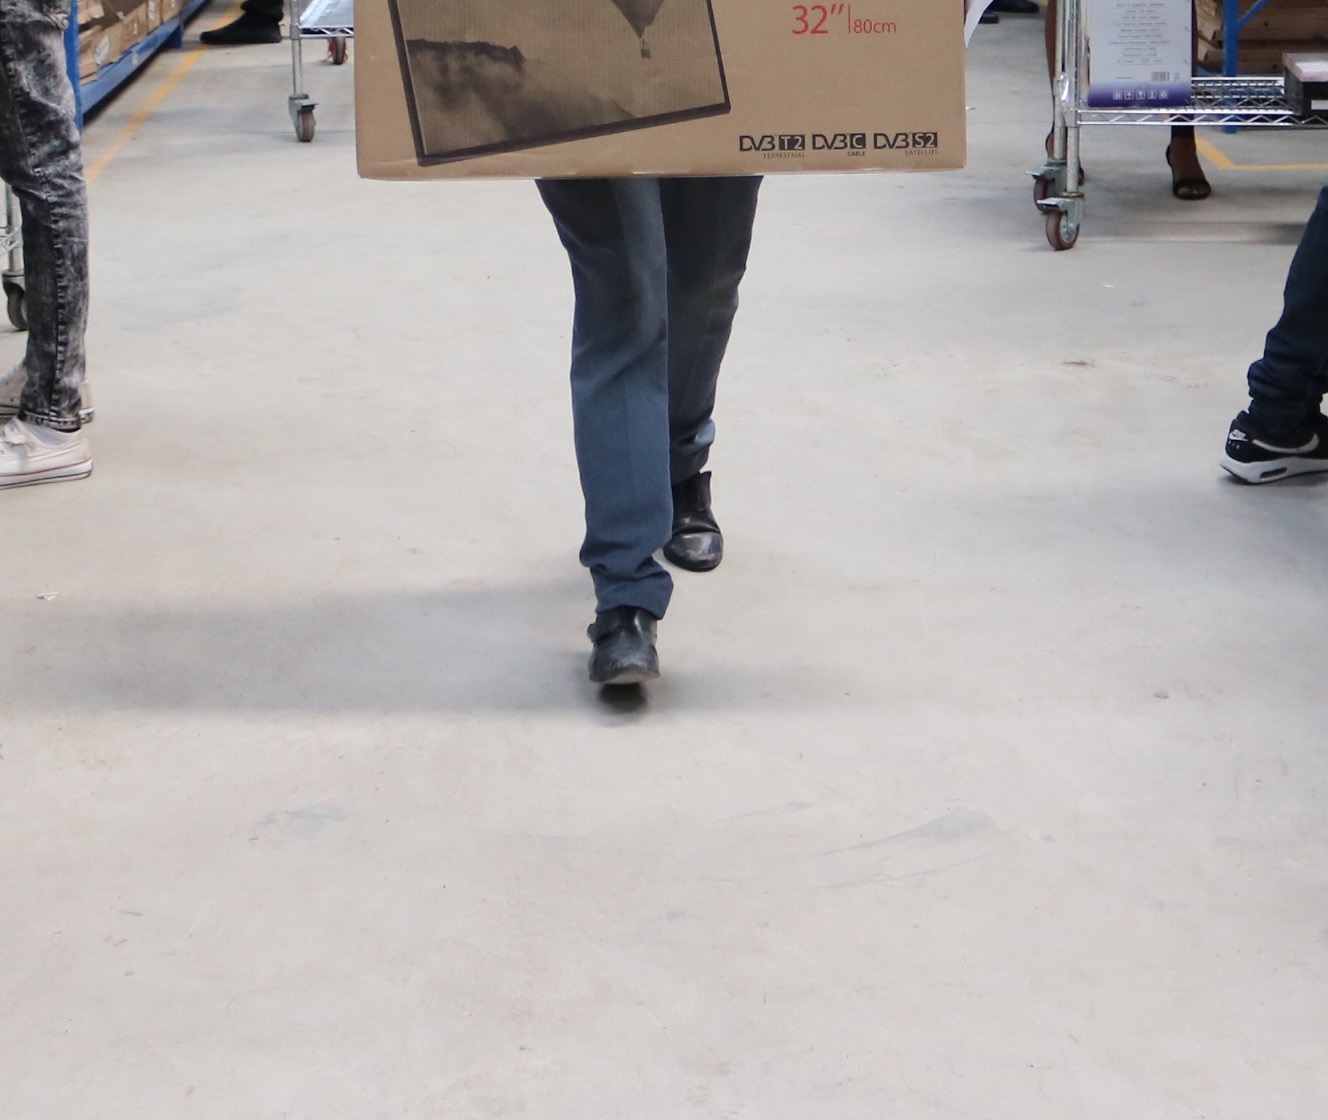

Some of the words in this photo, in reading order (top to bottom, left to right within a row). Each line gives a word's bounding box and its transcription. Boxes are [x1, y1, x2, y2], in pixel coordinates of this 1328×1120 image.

[853, 19, 897, 34] 80cm
[739, 135, 777, 152] DVB
[778, 134, 806, 150] T2
[812, 133, 849, 150] DVB
[873, 132, 910, 150] DVB
[911, 131, 938, 149] S2
